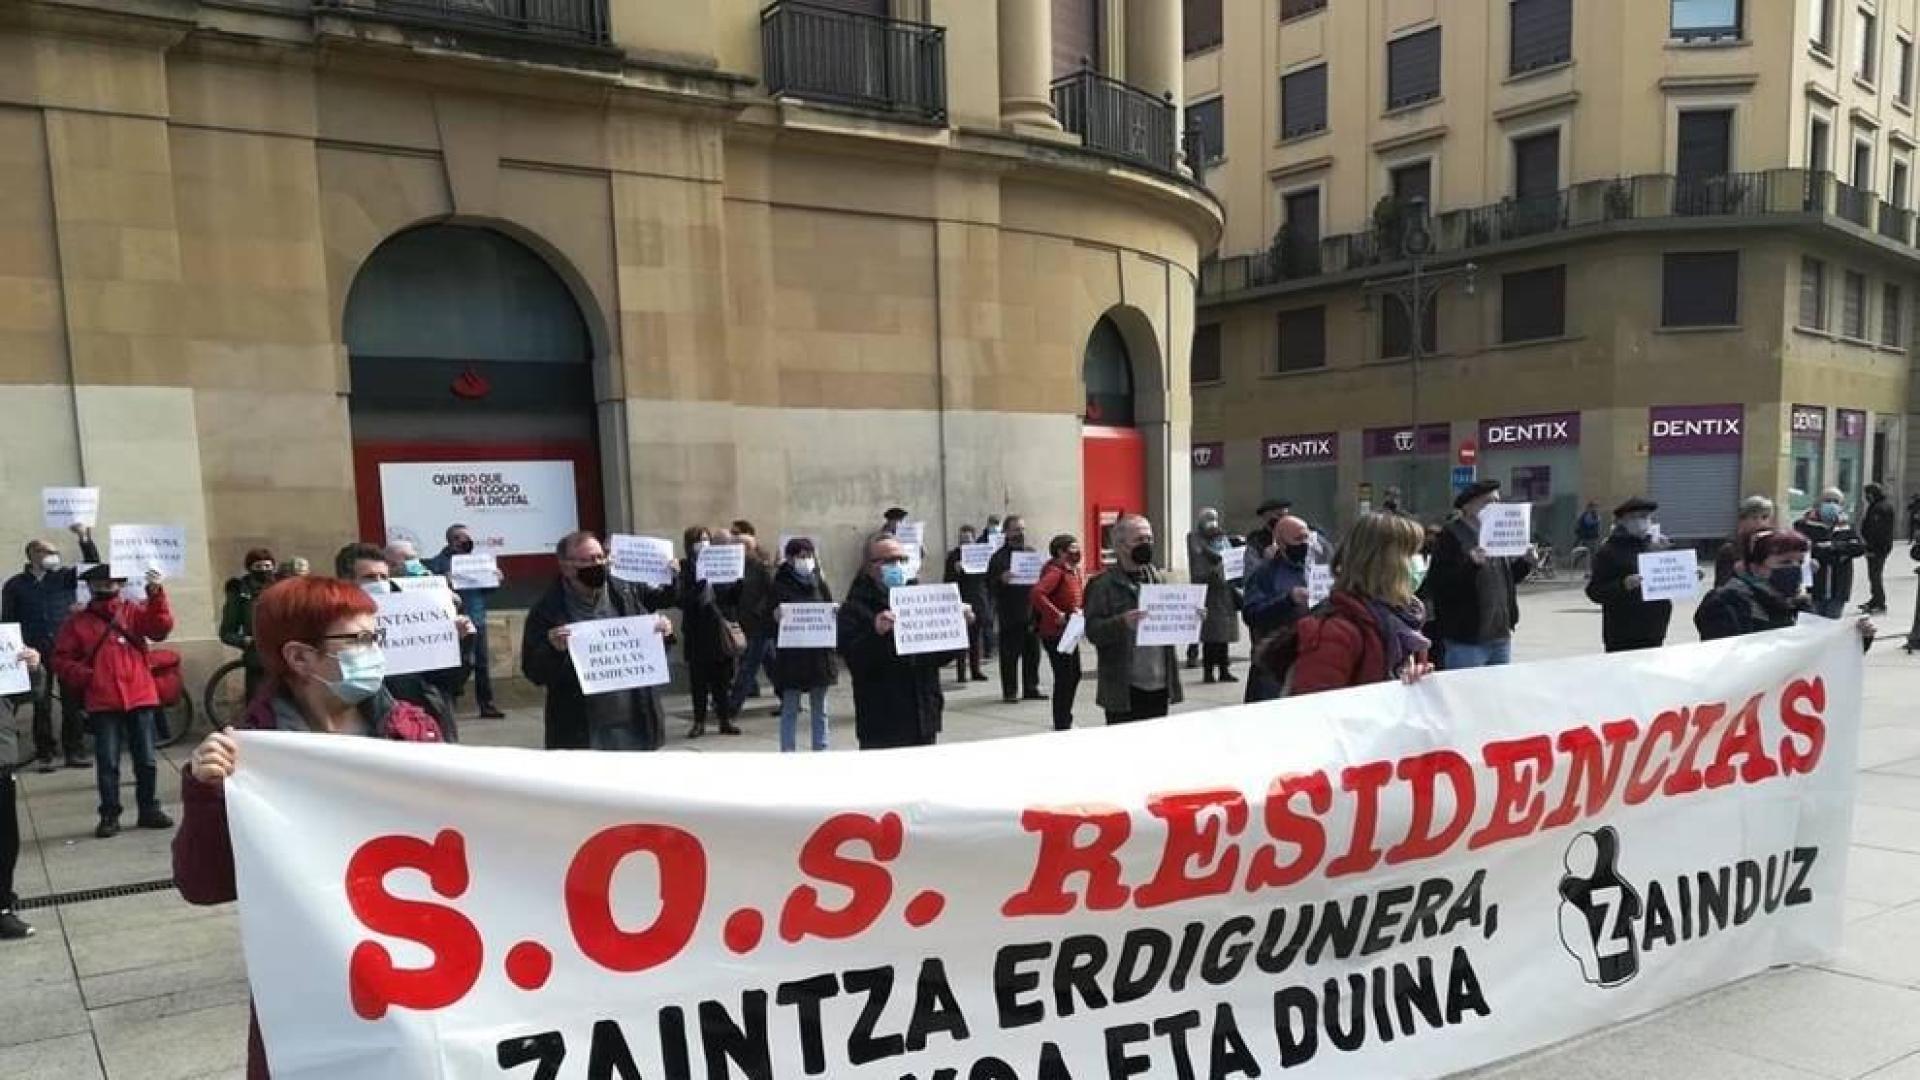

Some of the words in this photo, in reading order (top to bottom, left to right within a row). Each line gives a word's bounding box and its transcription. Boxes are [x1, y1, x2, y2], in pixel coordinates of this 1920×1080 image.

[1488, 421, 1569, 443] DENTIX
[1653, 418, 1739, 436] DENTIX
[1268, 438, 1332, 459] DENTIX
[432, 473, 477, 485] QUIERO
[478, 472, 503, 484] QUE
[451, 485, 466, 495] MI
[469, 483, 520, 495] NEGOCIO
[464, 496, 486, 506] SEA
[488, 494, 529, 506] DIGITAL
[376, 610, 450, 627] INTASUNA
[600, 625, 629, 638] VIDA
[589, 639, 640, 653] DECENTE
[590, 655, 621, 667] PARA
[622, 653, 645, 664] LAS
[583, 664, 655, 680] RESIDENTES
[345, 811, 946, 1020] S.O.S.
[1001, 676, 1829, 917] RESIDENCIAS
[1590, 846, 1819, 959] ZAINDUZ
[497, 957, 970, 1080] ZAINTZA
[994, 868, 1498, 1030] ERDIGUNERA,
[1104, 1002, 1262, 1080] ETA
[1273, 945, 1491, 1069] DUINA
